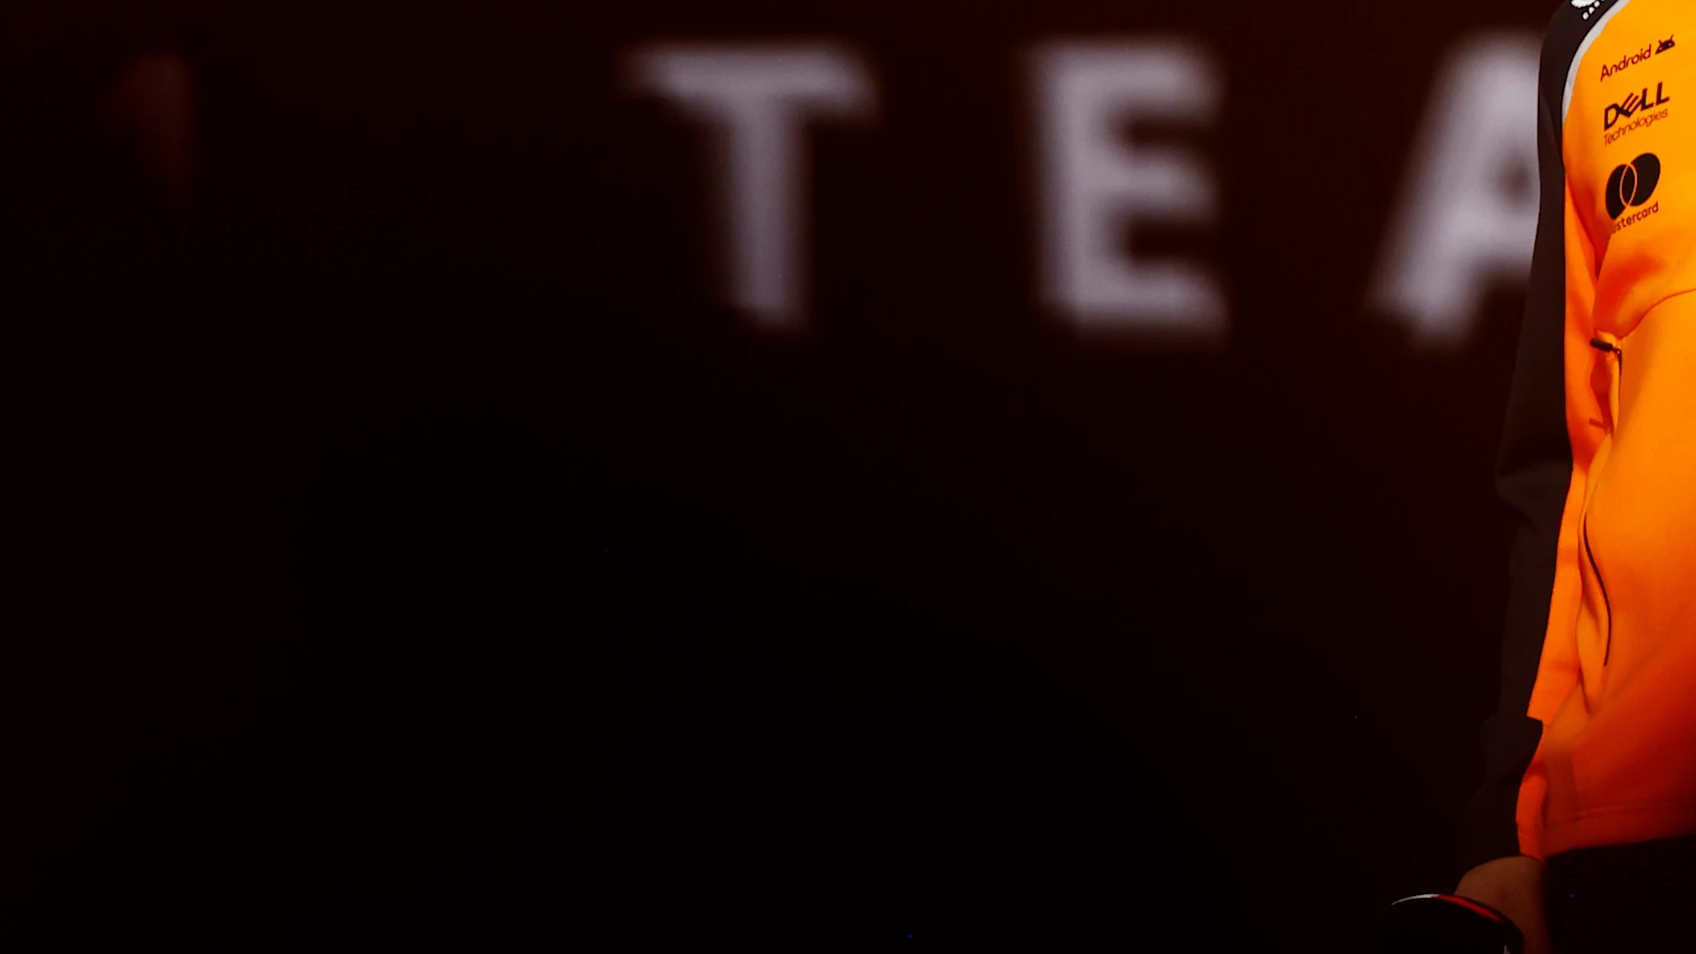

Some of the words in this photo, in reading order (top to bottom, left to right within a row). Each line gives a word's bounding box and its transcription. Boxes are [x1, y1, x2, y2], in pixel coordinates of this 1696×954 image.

[1600, 43, 1652, 82] Android
[1603, 81, 1670, 132] DELL
[1603, 108, 1669, 147] Technologies
[1611, 200, 1659, 234] stercard
